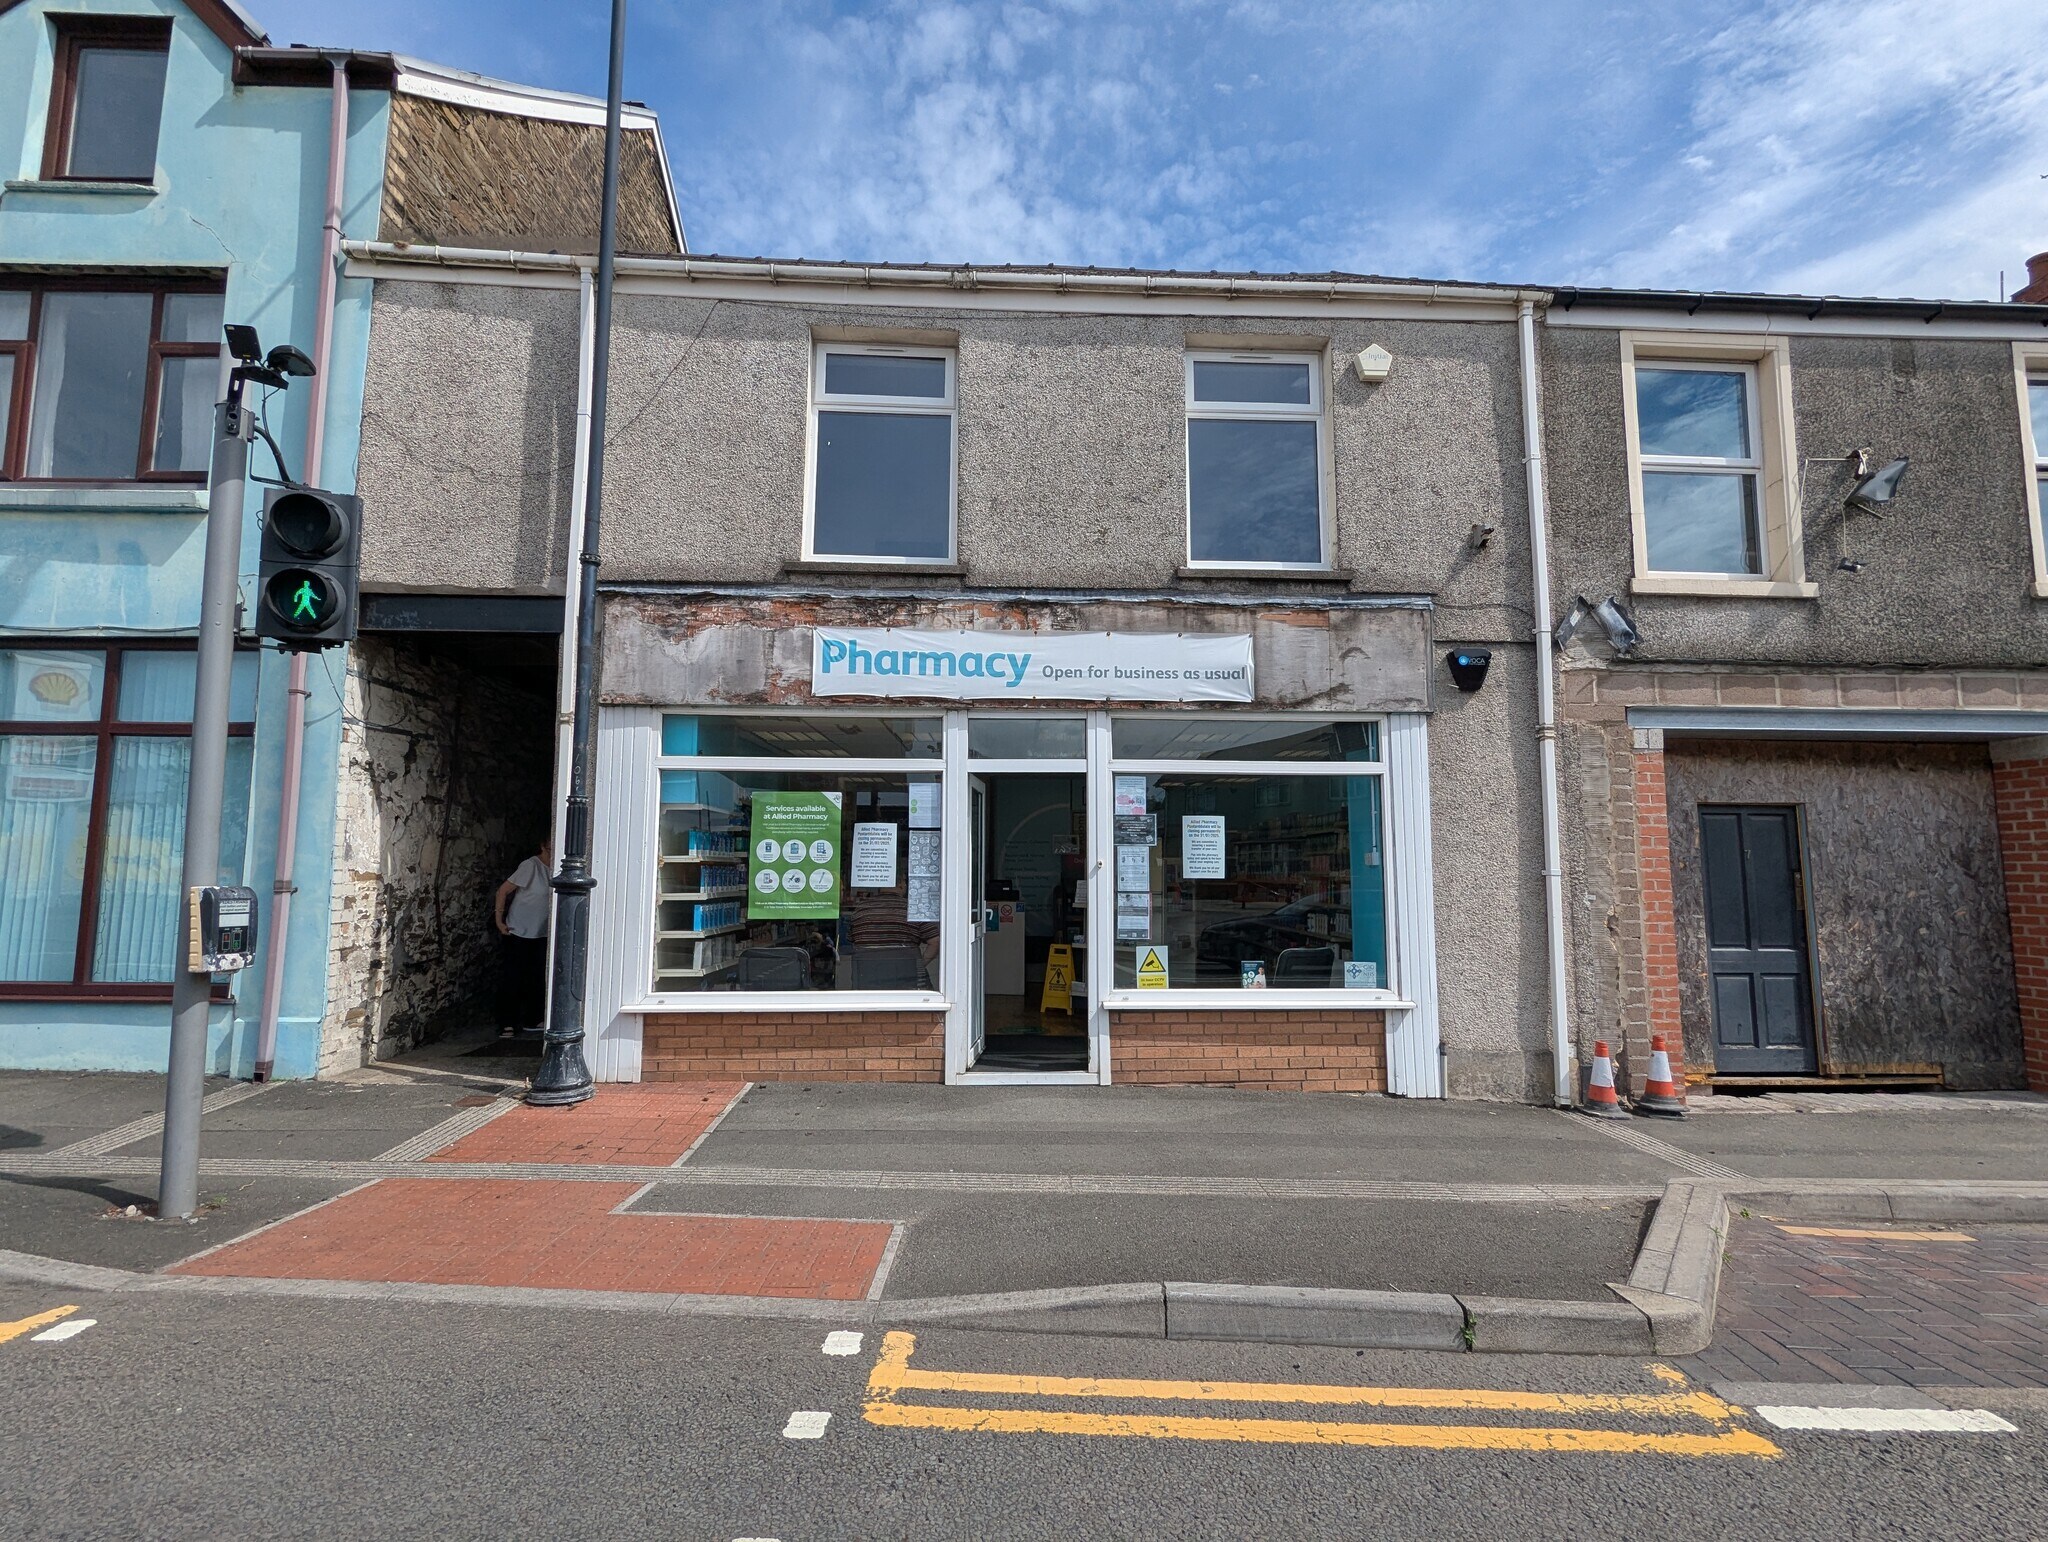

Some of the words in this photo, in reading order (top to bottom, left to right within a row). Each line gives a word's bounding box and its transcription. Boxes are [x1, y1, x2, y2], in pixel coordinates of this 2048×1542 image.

[822, 639, 1031, 687] Pharmacy
[1042, 665, 1082, 681] Open
[1087, 666, 1110, 678] for
[1114, 666, 1179, 679] business
[1183, 669, 1200, 680] as
[1205, 667, 1245, 680] usual
[1744, 850, 1751, 859] 7
